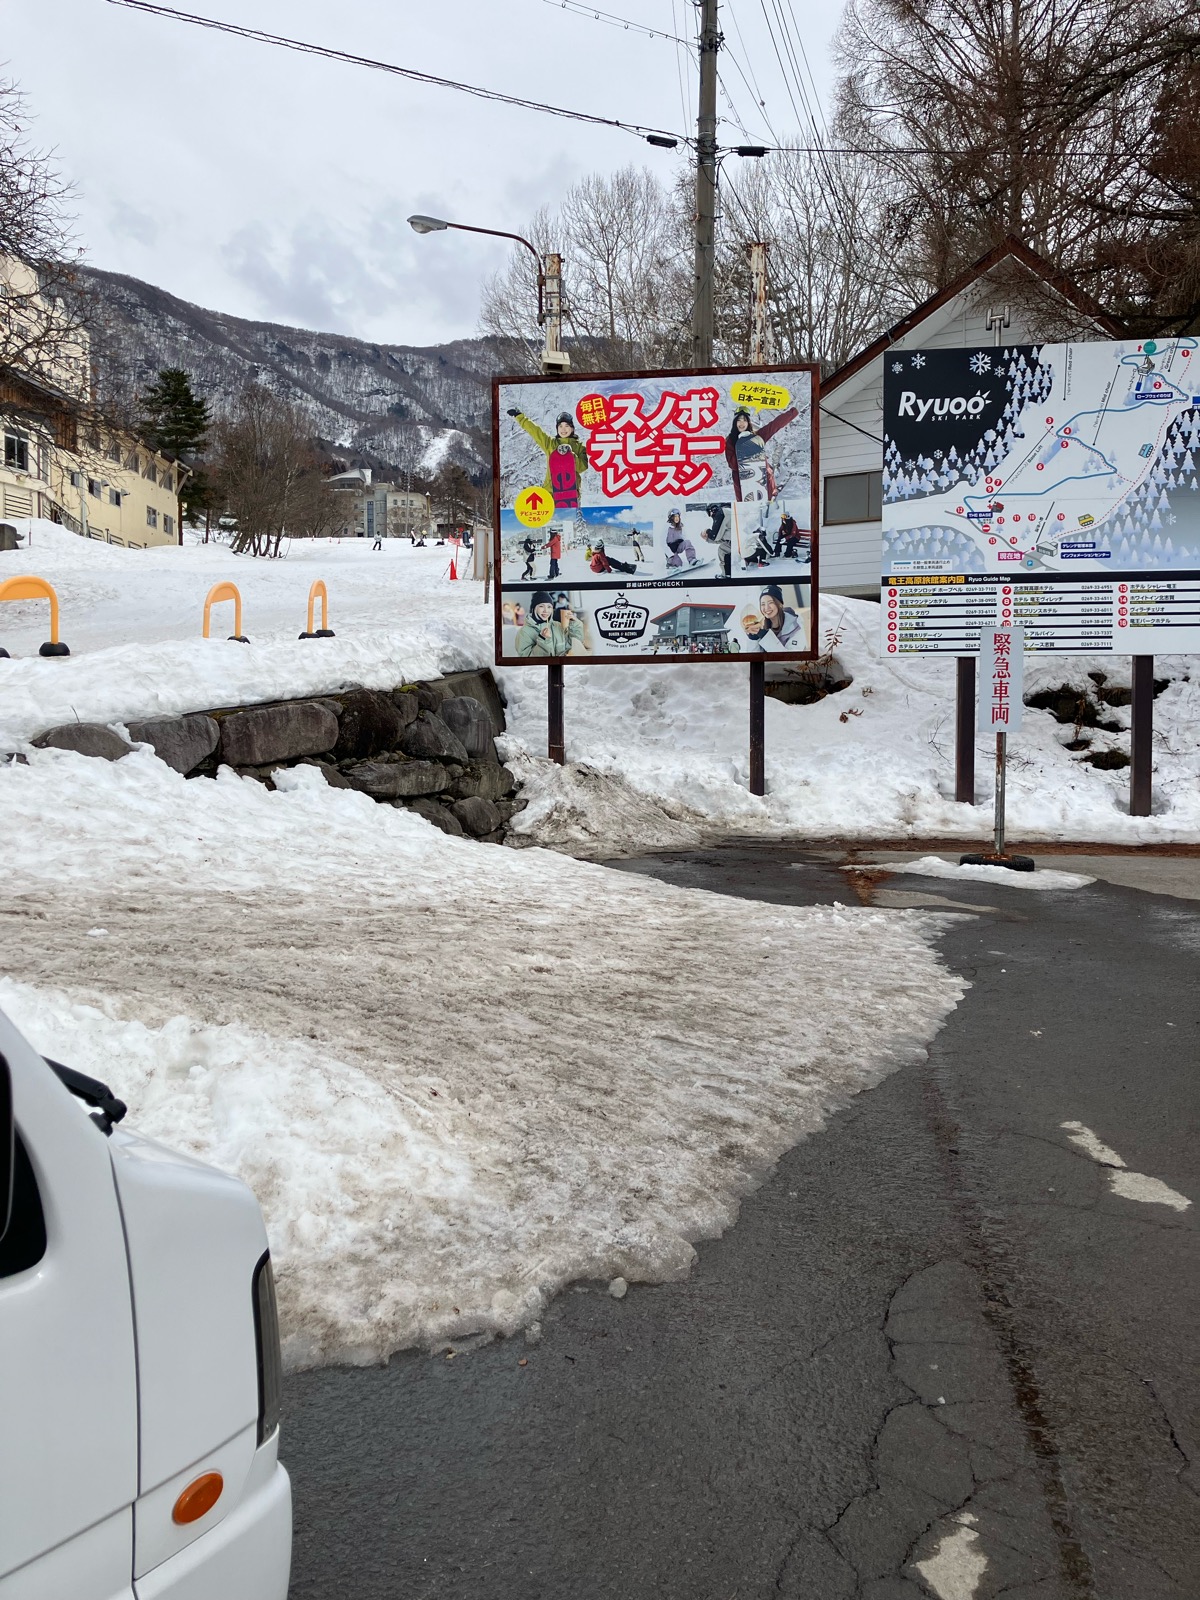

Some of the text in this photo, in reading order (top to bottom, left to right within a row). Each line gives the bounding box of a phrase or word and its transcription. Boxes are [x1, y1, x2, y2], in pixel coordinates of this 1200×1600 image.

[741, 385, 782, 395] スノボデビュー
[580, 398, 604, 412] 毎日
[610, 392, 714, 430] スノボ
[898, 391, 985, 422] Ryuoo
[582, 409, 607, 426] 無料
[590, 430, 720, 466] デビュー
[606, 465, 708, 493] レッスン
[888, 576, 965, 585] 竜王高原旅館案内図
[602, 609, 642, 621] Spirits
[610, 619, 636, 628] Grill
[992, 633, 1011, 724] 緊急車両
